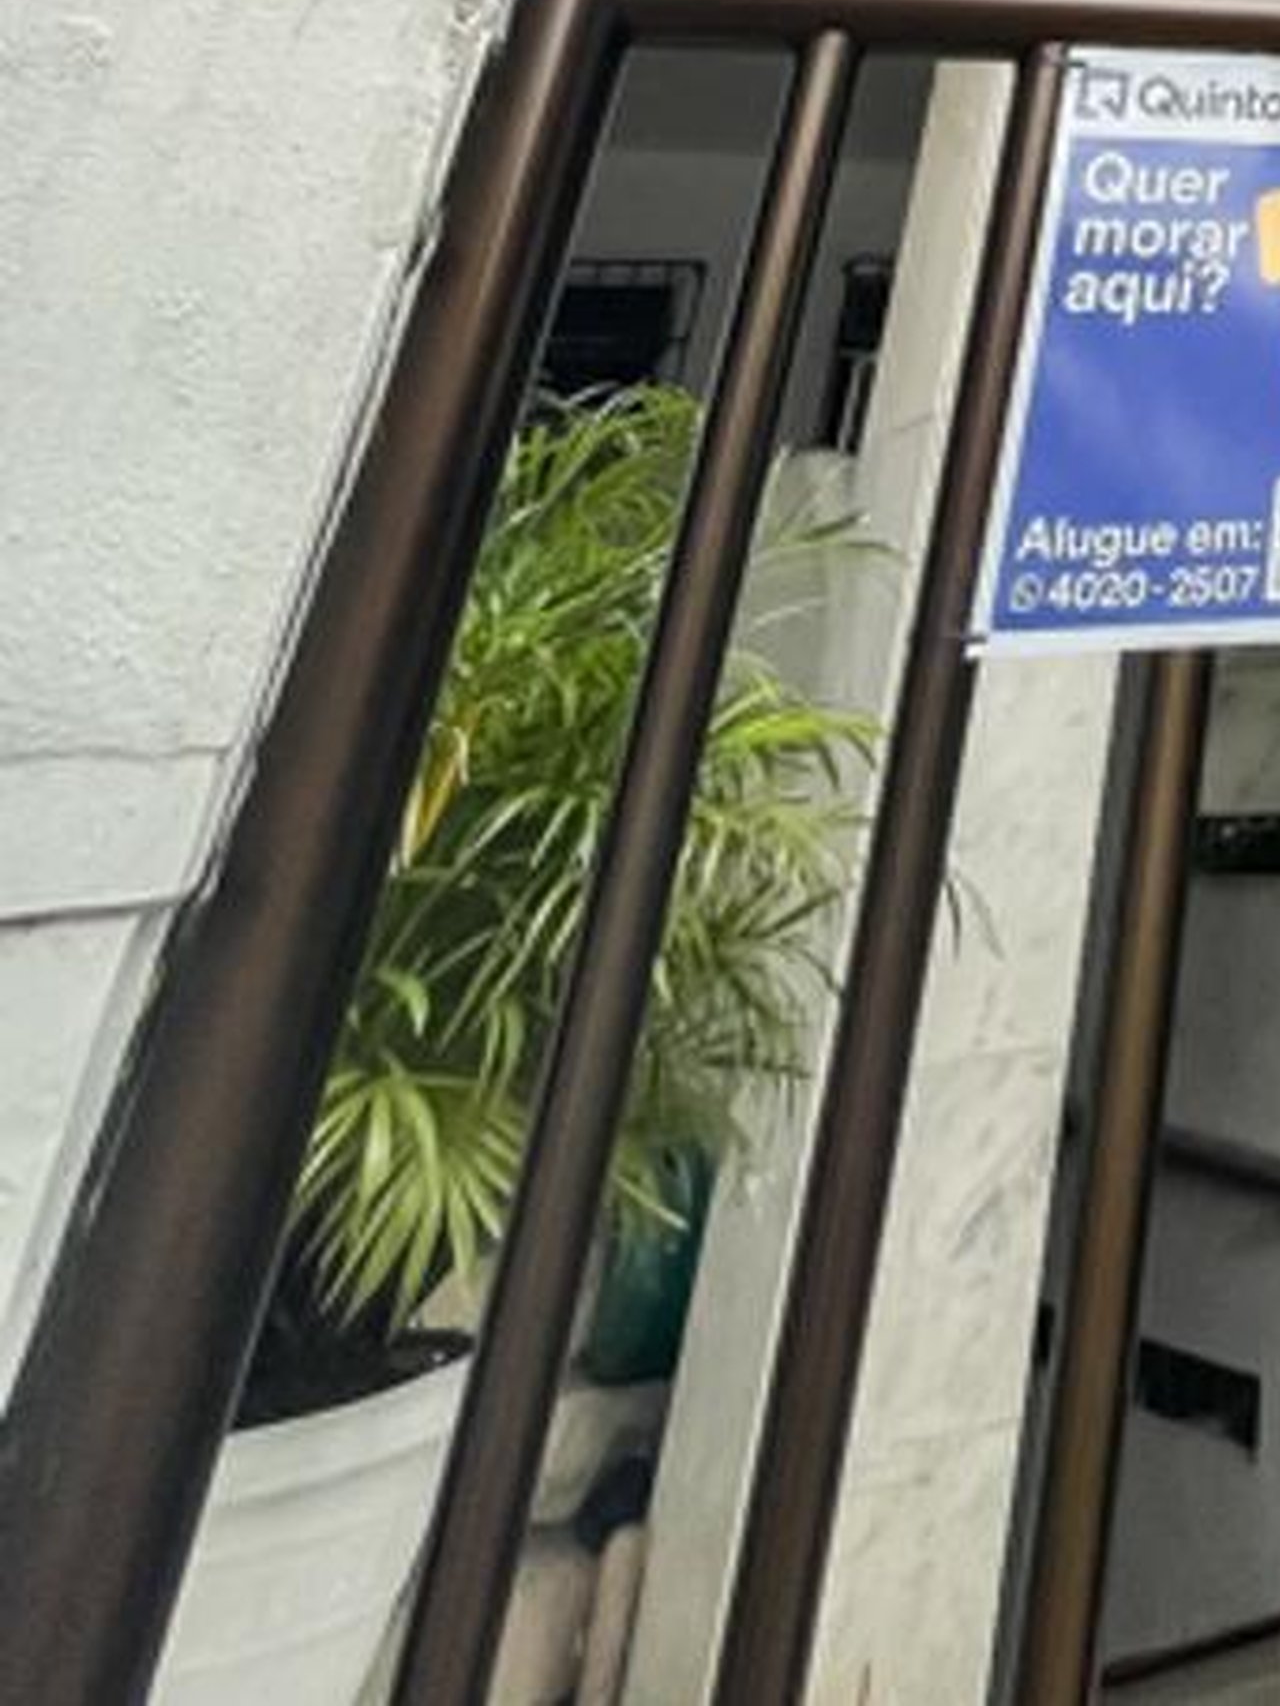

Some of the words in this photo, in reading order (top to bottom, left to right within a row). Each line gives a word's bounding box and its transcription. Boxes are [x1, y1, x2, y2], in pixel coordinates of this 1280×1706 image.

[1084, 152, 1231, 204] Quer
[1073, 218, 1249, 258] morar
[1064, 261, 1231, 325] aqui?
[1015, 516, 1179, 568] Alugue
[1186, 519, 1264, 556] em:
